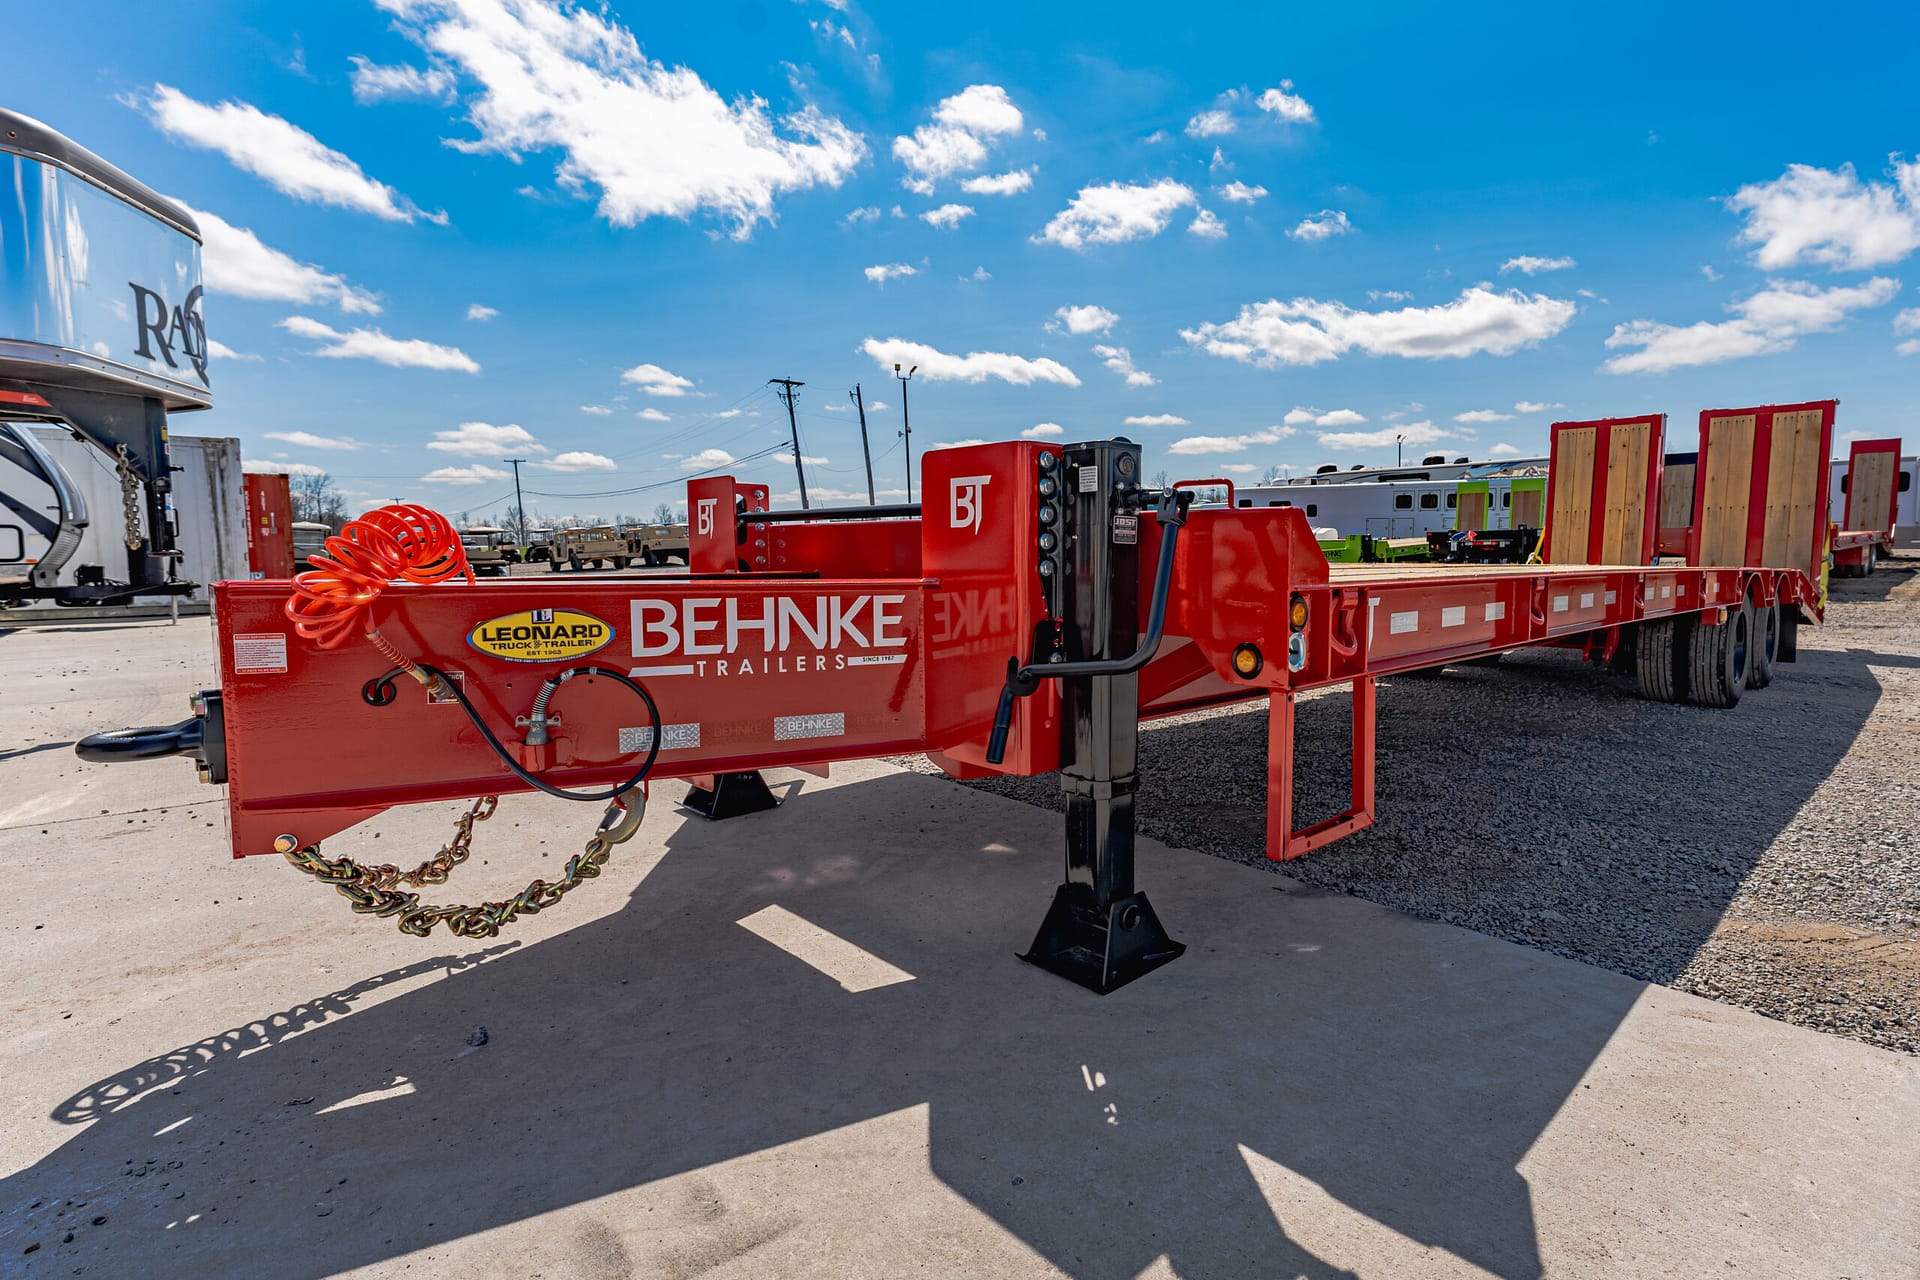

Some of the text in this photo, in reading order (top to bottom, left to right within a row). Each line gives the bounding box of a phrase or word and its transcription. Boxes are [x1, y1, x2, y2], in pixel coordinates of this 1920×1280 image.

[950, 475, 992, 535] BT
[698, 498, 717, 539] BT
[481, 624, 603, 642] LEONARD
[630, 595, 907, 657] BEHNKE
[490, 641, 532, 650] TRUCK
[543, 639, 593, 649] TRAILER
[697, 654, 845, 677] TRAILERS
[787, 718, 832, 732] BEHNKE
[635, 730, 686, 744] BENKE
